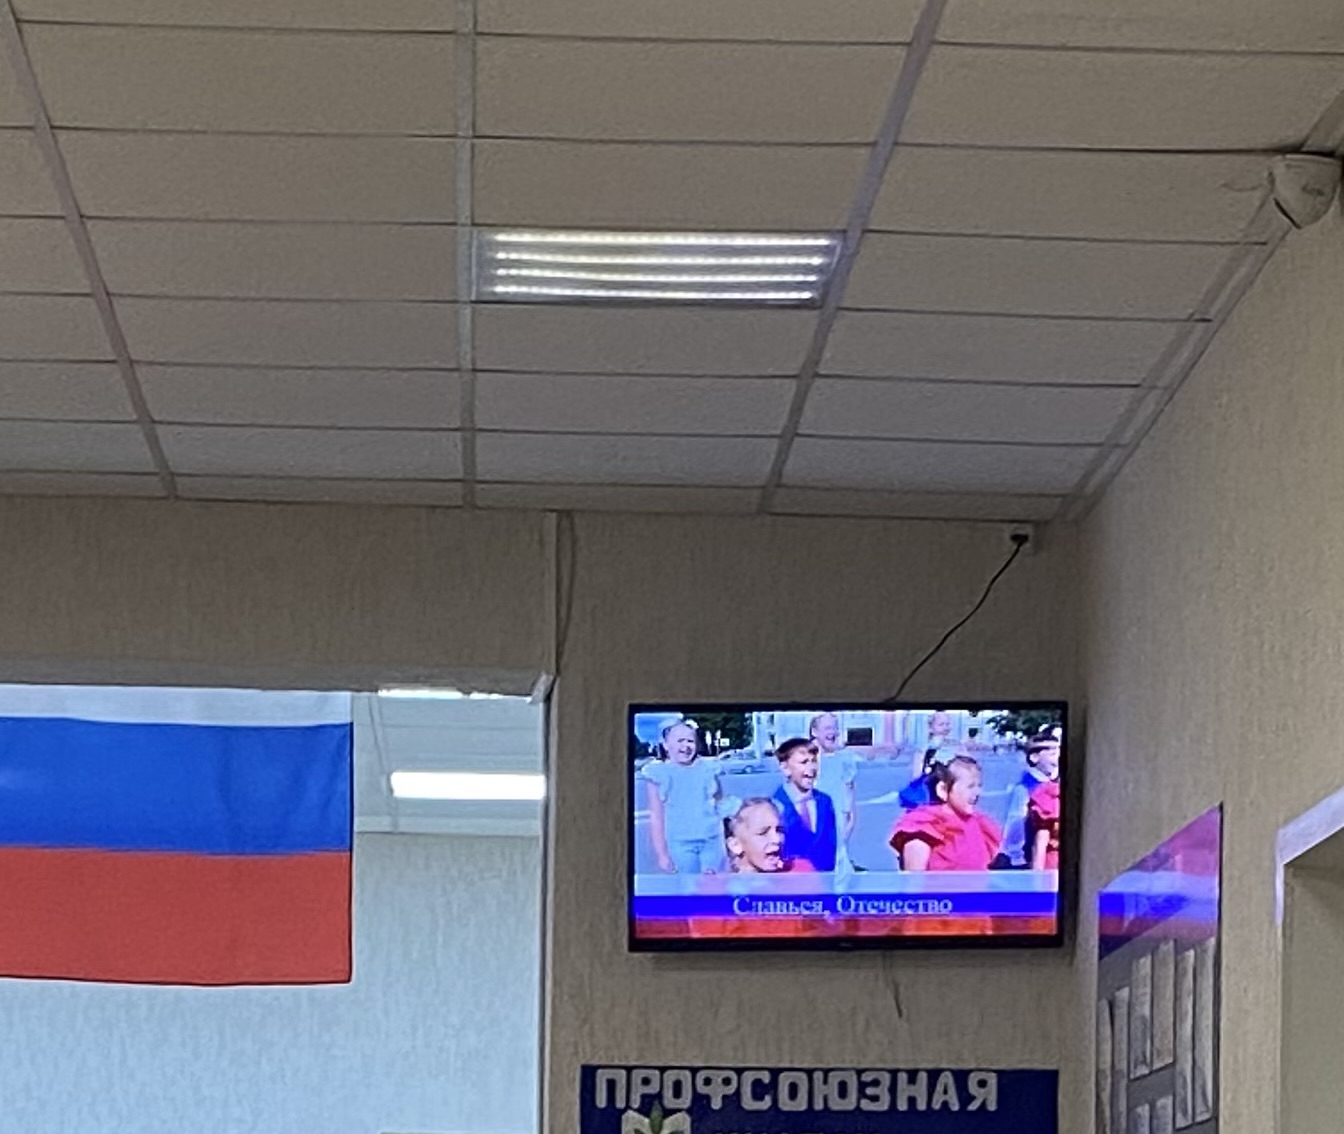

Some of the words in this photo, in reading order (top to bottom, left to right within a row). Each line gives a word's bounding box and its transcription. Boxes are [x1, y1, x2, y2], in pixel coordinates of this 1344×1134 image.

[733, 895, 832, 919] Славься,
[836, 895, 953, 916] Отечество
[595, 1067, 999, 1112] ПРОФСОЮЗНАЯ
